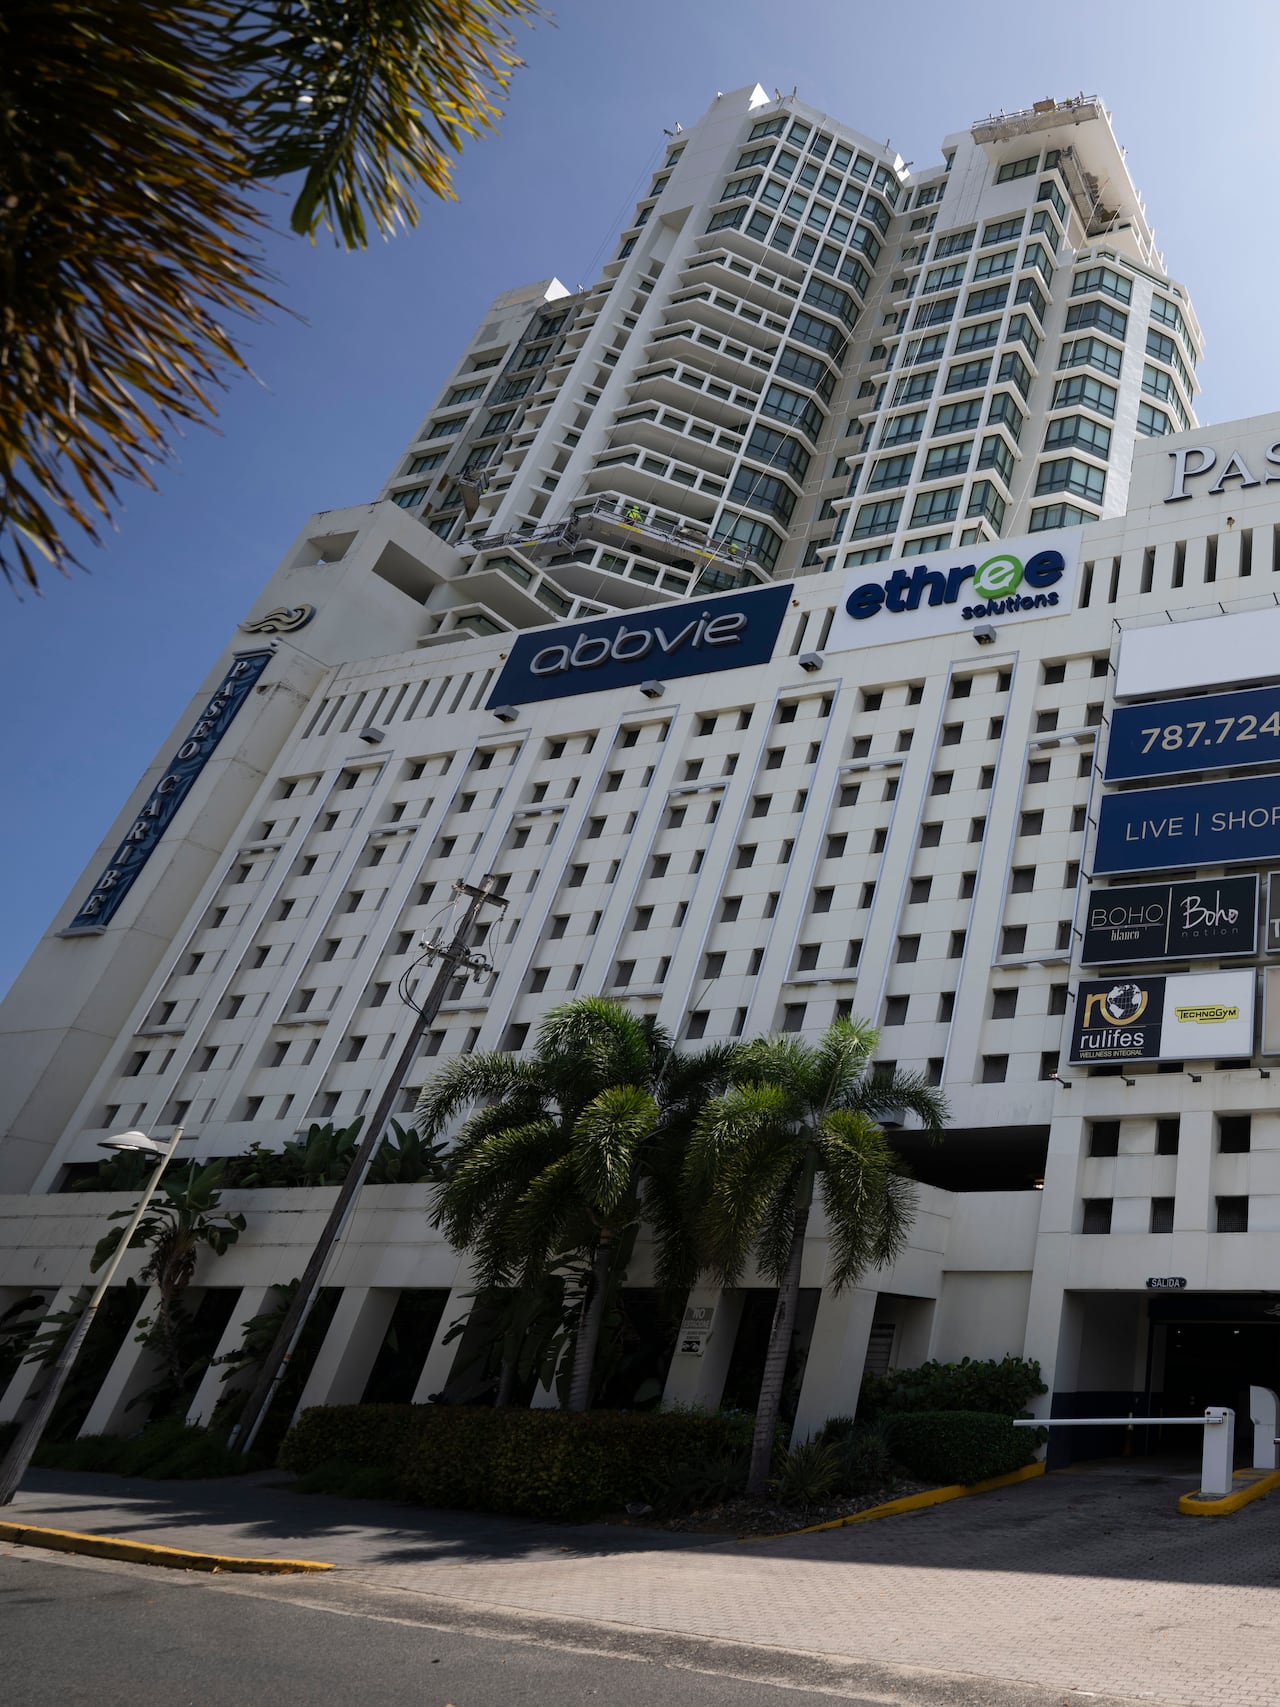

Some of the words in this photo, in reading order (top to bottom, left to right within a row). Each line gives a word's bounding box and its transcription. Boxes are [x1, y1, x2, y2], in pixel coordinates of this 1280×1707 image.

[846, 550, 1066, 621] ethree
[962, 589, 1060, 621] solutions
[529, 609, 748, 677] abbvie
[178, 661, 248, 760] PASEO
[1125, 816, 1184, 842] LIVE
[81, 775, 181, 917] CARIBE
[1091, 904, 1164, 928] BOHO
[1180, 890, 1239, 929] Boho
[1110, 929, 1140, 942] blanco
[1181, 927, 1239, 937] nation
[1080, 1029, 1145, 1049] rulifes
[1151, 1278, 1181, 1288] SALIDA
